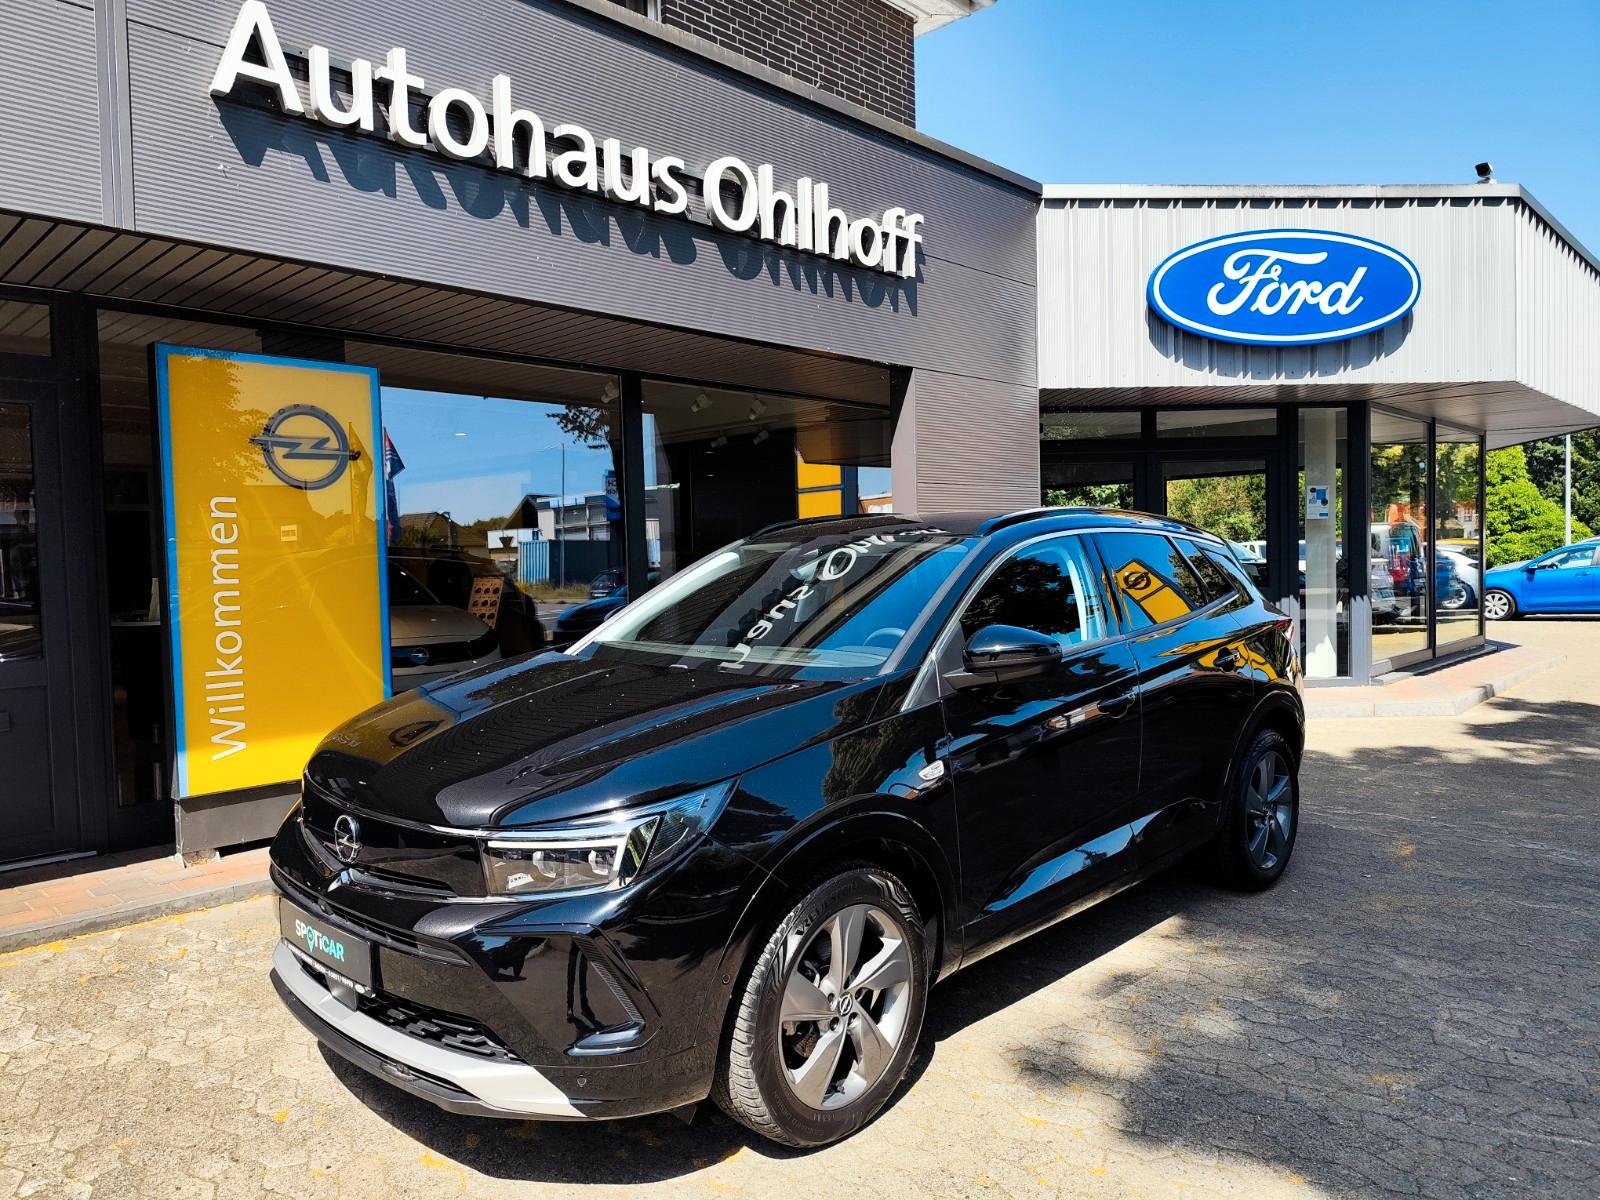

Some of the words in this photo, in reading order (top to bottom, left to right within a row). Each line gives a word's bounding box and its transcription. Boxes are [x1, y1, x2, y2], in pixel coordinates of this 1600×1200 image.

[208, 0, 690, 214] Autohaus
[703, 156, 925, 279] Ohlhoff
[1206, 248, 1368, 316] Ford
[205, 496, 247, 761] Willkommen
